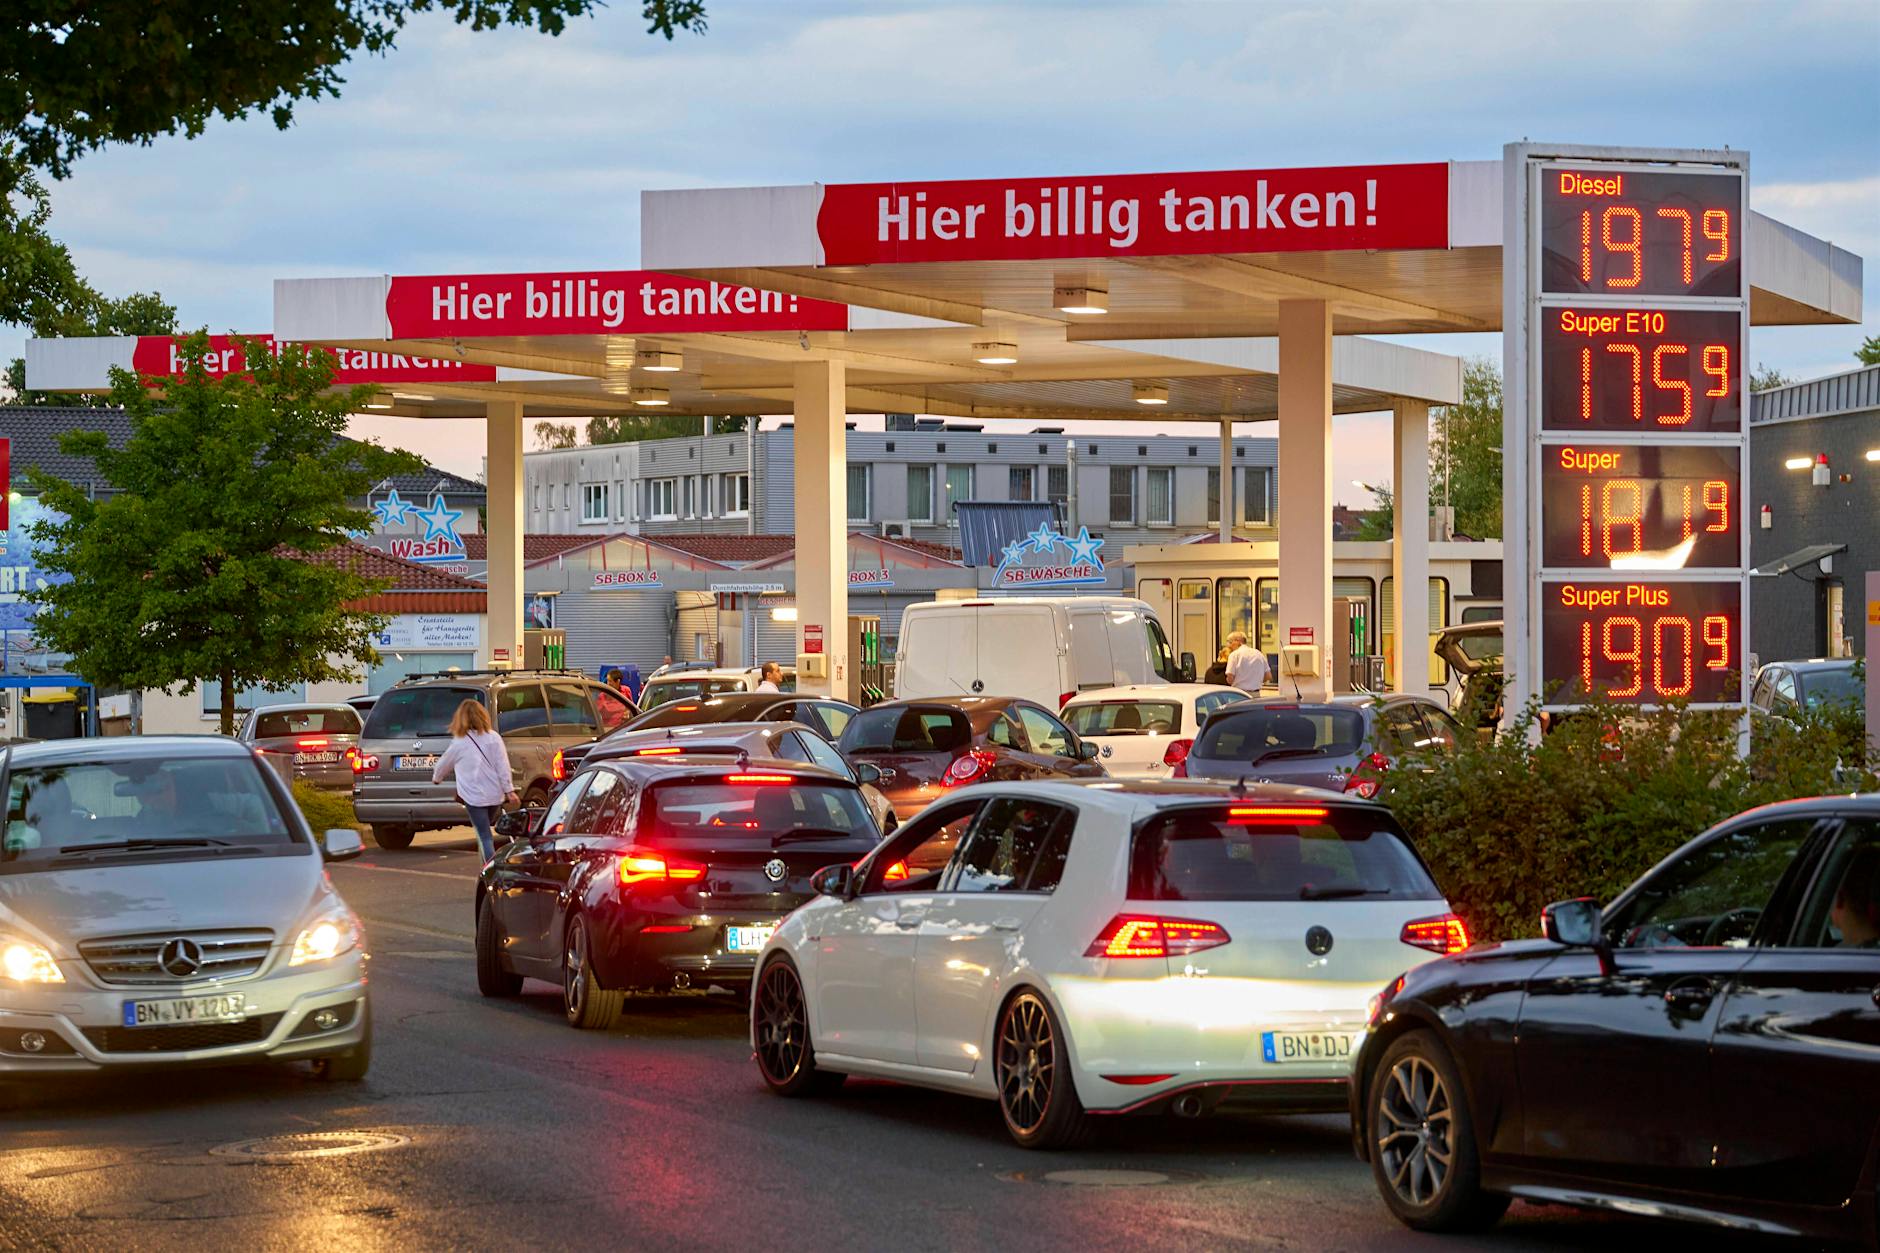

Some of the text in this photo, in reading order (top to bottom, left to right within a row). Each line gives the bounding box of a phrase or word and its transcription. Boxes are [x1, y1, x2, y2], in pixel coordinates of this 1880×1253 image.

[1560, 173, 1622, 195] Diesel
[878, 179, 1377, 248] Hier billig tanken!
[432, 282, 511, 320] Hier
[526, 279, 625, 328] billig
[1561, 311, 1664, 337] Super E10
[170, 344, 234, 373] Her
[1561, 448, 1620, 473] Super
[391, 536, 450, 558] Wash
[594, 570, 659, 585] SB-BOX 4
[879, 569, 890, 581] 3
[1003, 564, 1093, 583] SB-WÄSCHE
[712, 584, 763, 592] Durchfahrtshöhe
[1561, 585, 1669, 611] Super Plus
[402, 758, 413, 767] BN
[740, 931, 761, 946] LH
[136, 1004, 160, 1023] BN
[172, 999, 195, 1020] VY
[1283, 1036, 1350, 1057] BN DJ
